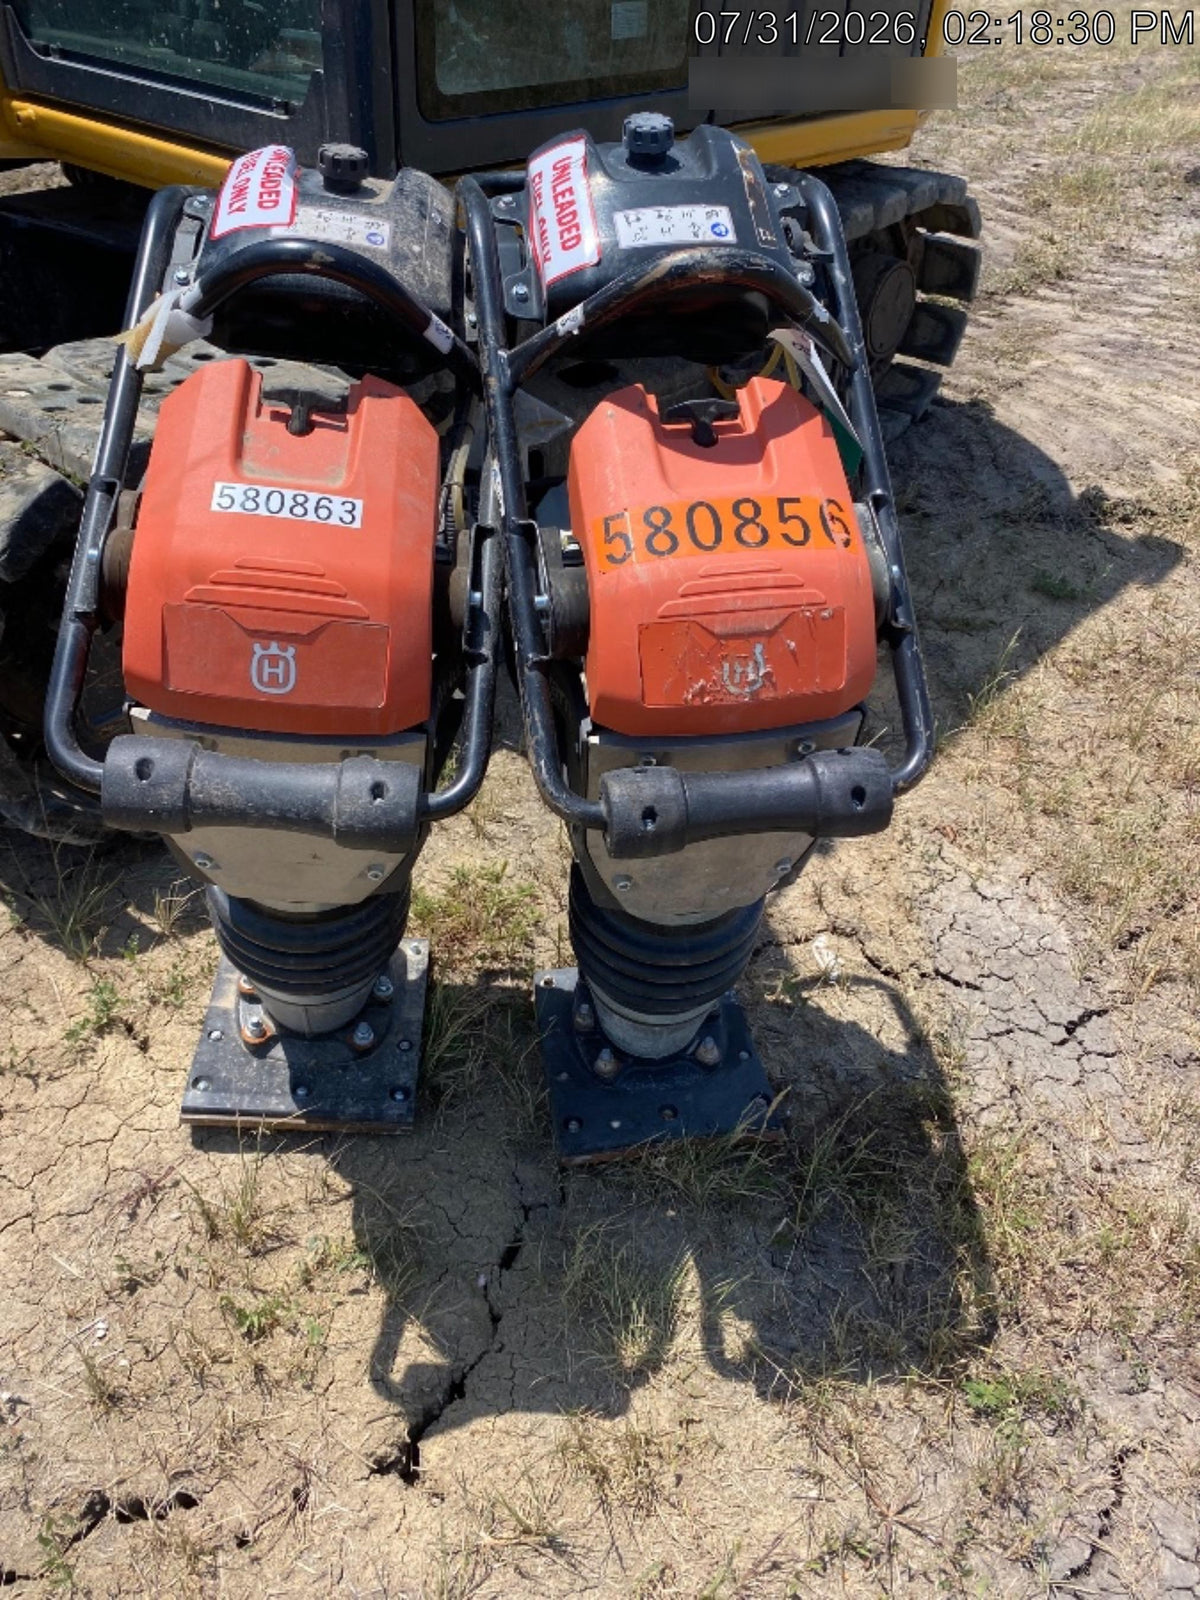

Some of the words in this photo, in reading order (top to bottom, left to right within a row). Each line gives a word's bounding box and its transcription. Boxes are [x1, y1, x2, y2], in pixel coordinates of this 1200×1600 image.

[227, 177, 251, 215] ONLY
[257, 149, 290, 210] UNLEADED
[551, 156, 582, 252] UNLEADED
[216, 485, 357, 525] 580863
[603, 497, 851, 564] 580856
